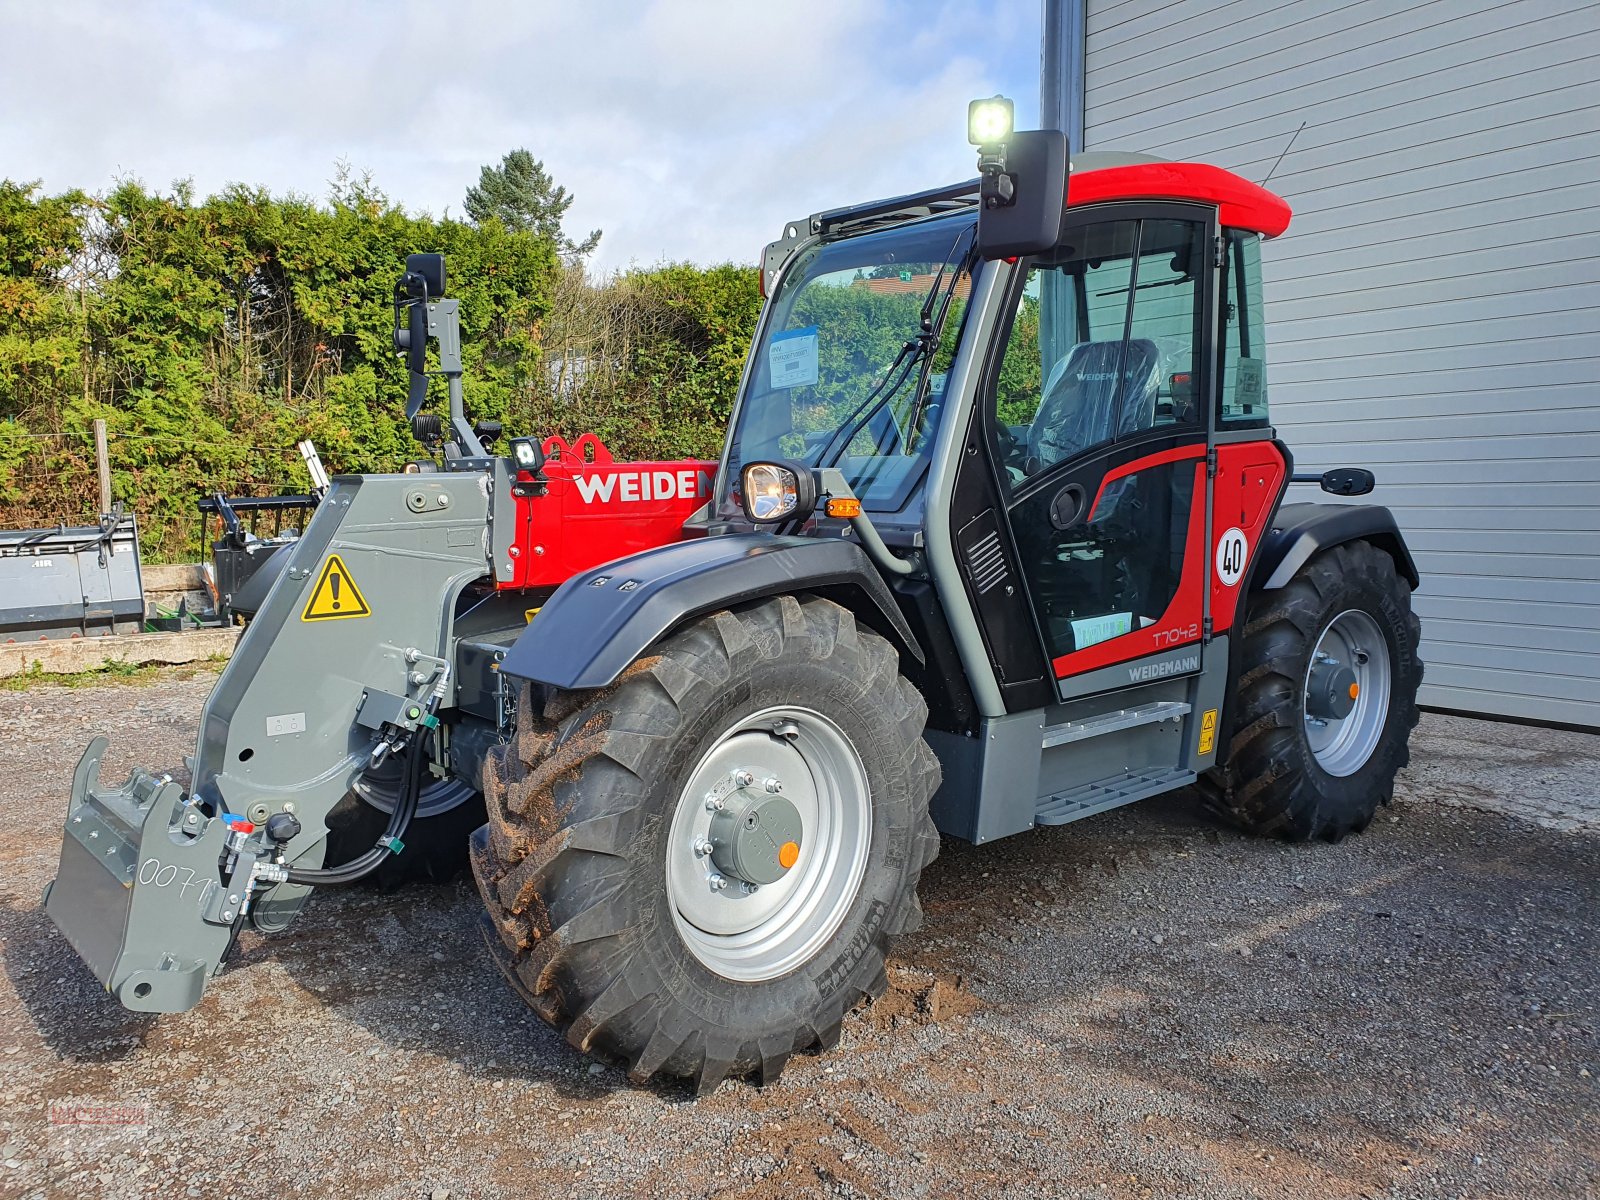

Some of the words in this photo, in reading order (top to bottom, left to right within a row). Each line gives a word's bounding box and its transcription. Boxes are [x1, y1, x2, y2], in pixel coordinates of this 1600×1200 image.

[1223, 539, 1241, 575] 40
[1152, 623, 1198, 647] T7042
[1128, 656, 1198, 681] WEIDEMANN
[139, 858, 216, 902] 0071
